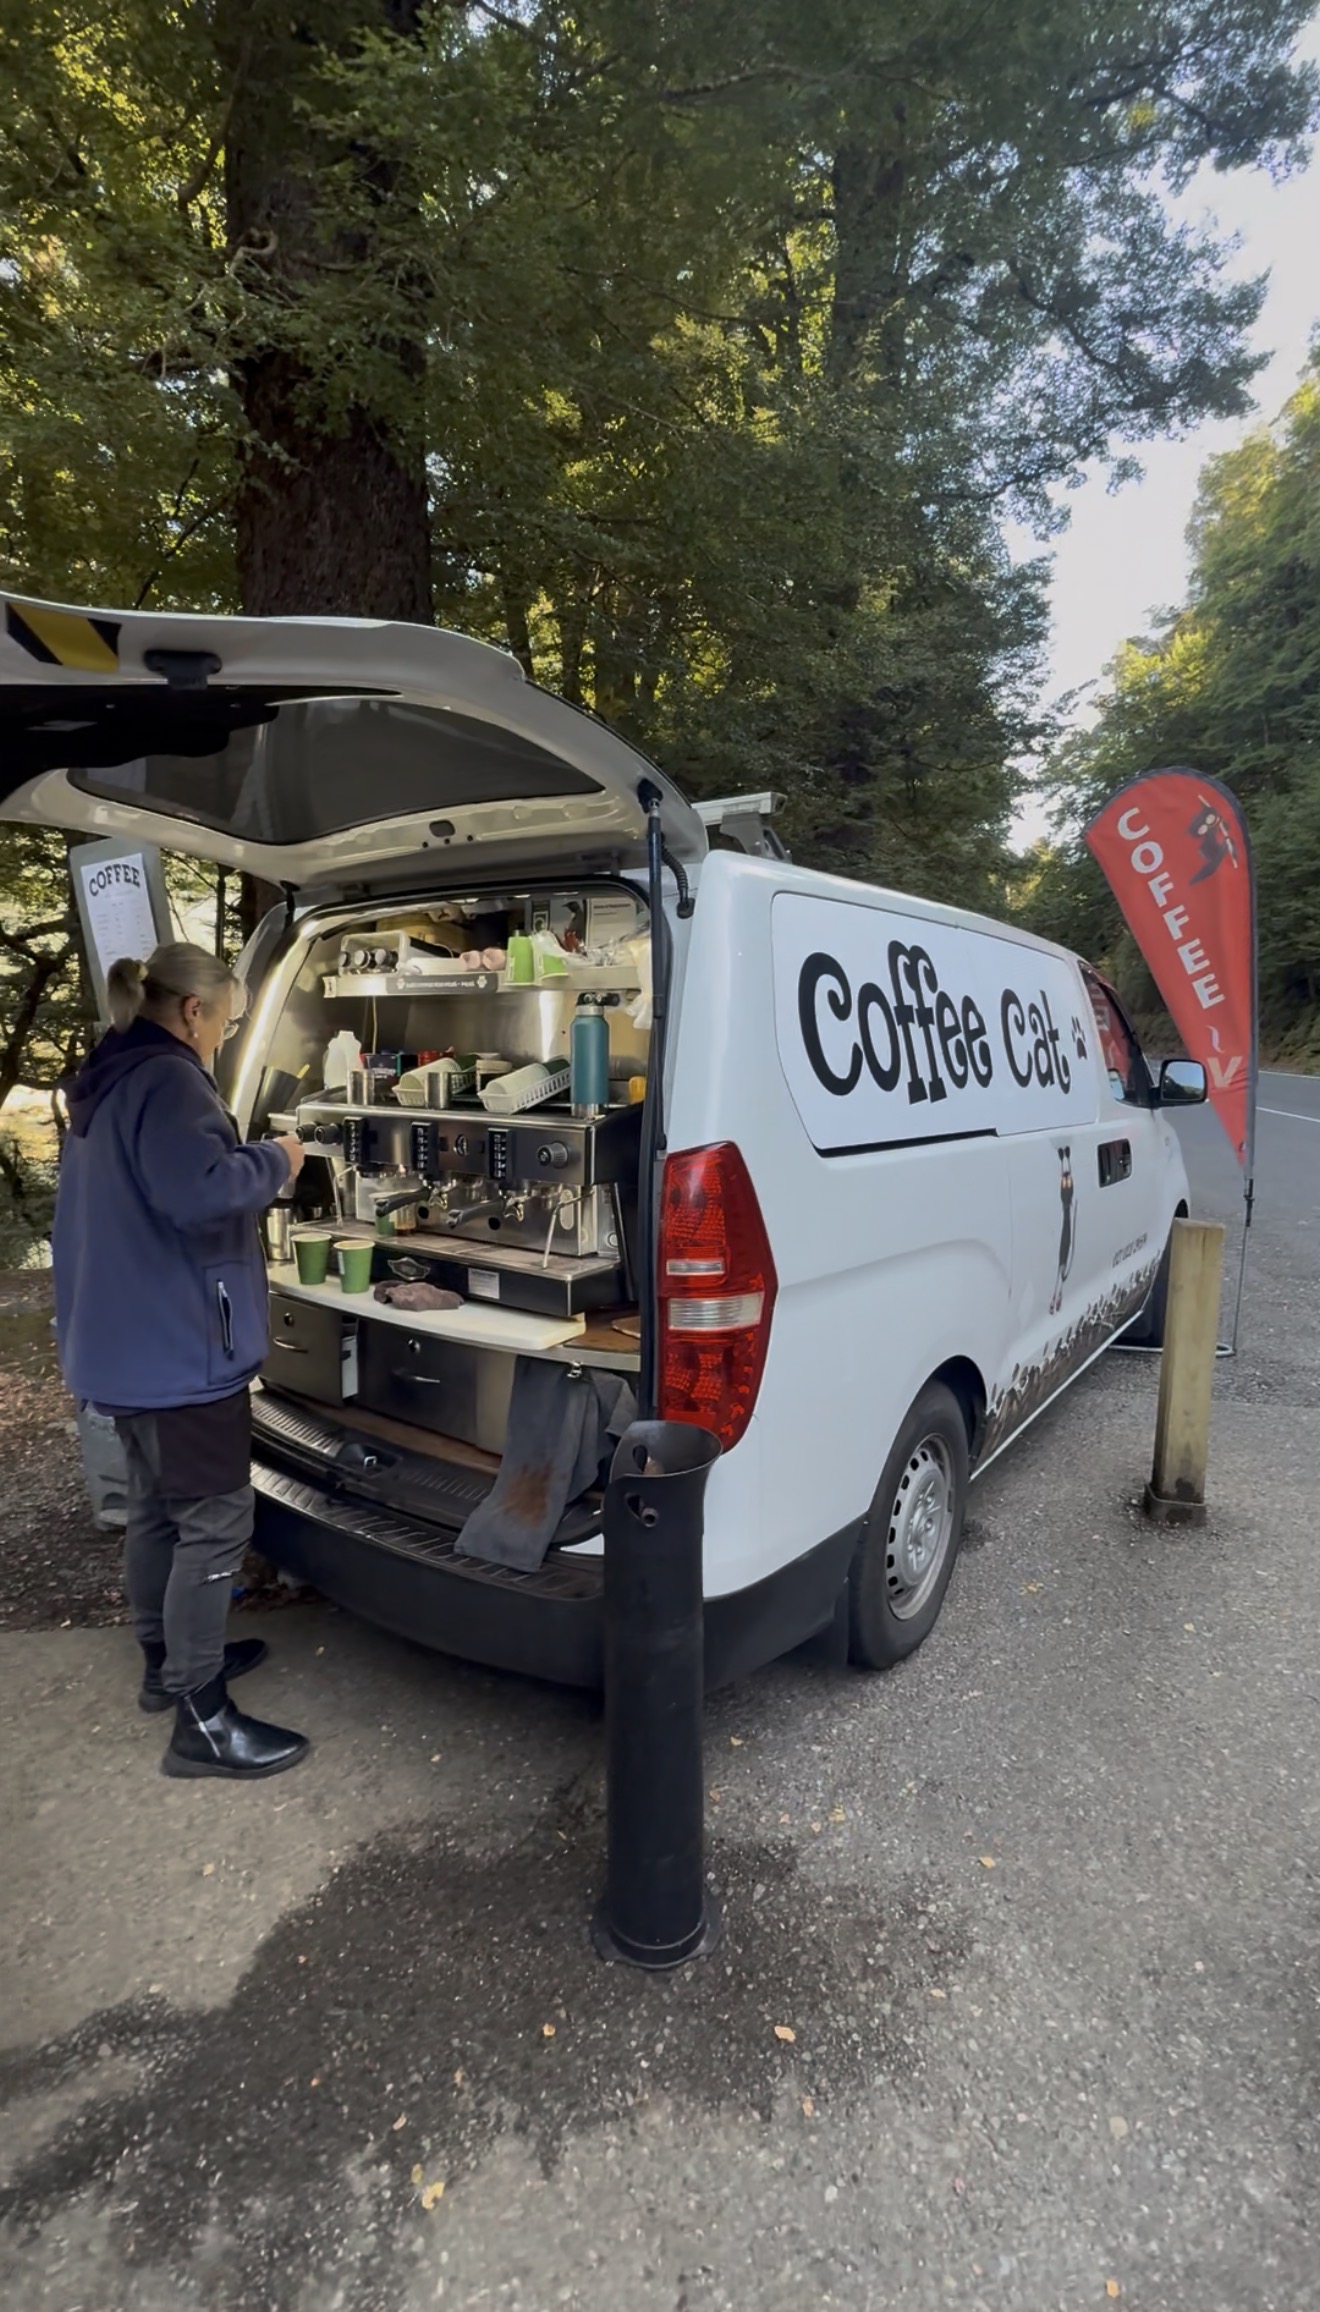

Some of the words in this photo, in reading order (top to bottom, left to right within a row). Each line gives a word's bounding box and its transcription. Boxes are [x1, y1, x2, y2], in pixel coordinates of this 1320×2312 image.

[89, 864, 140, 896] COFFEE
[1117, 807, 1226, 1009] COFFEE
[798, 940, 993, 1104] Coffee
[1001, 988, 1072, 1095] Cat
